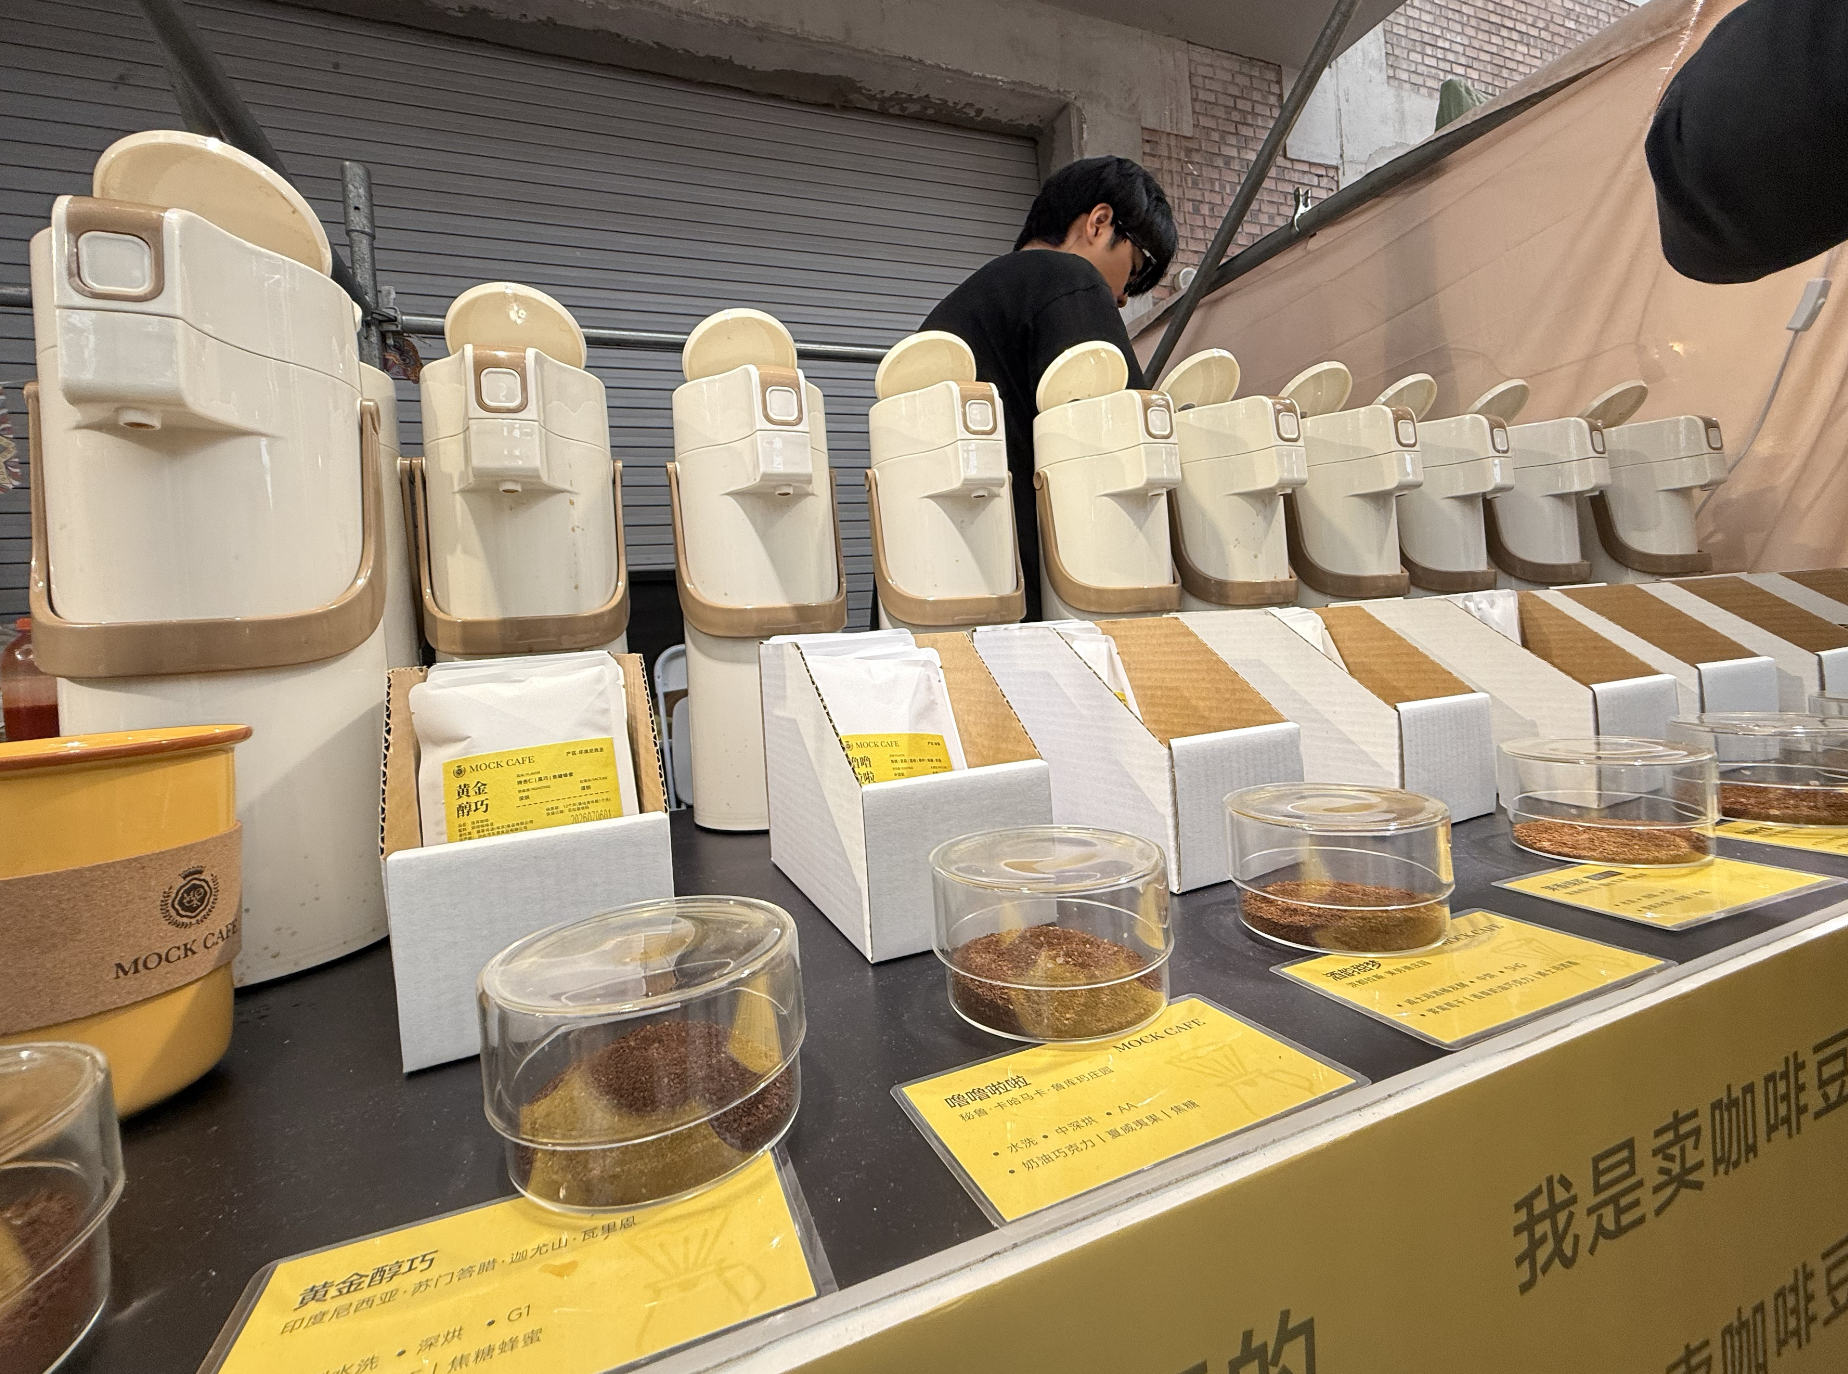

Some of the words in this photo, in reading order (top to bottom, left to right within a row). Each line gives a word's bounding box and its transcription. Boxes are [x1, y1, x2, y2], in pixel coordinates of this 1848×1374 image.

[855, 741, 880, 749] MOCK
[880, 740, 900, 748] CAFE
[468, 759, 504, 774] MOCK
[506, 755, 535, 767] CAFE
[455, 780, 488, 801] 黄金
[456, 798, 490, 819] 醇巧
[113, 938, 199, 980] MOCK
[202, 918, 238, 950] CAFE
[1504, 962, 1528, 972] SHG
[1112, 1031, 1165, 1053] MOCK
[1163, 1018, 1206, 1036] CAFE
[944, 1074, 1032, 1109] 噜噜啦啦
[1007, 1136, 1039, 1154] 水洗
[1054, 1115, 1099, 1137] 中深烘
[1117, 1102, 1138, 1114] AA
[1021, 1137, 1096, 1172] 奶油巧克力
[1104, 1113, 1164, 1140] 夏威夷果
[1169, 1099, 1201, 1116] 焦糖
[292, 1249, 439, 1311] 黄金醇巧
[416, 1325, 464, 1355] 深烘
[506, 1303, 531, 1323] G1
[446, 1326, 543, 1374] 焦糖蜂蜜
